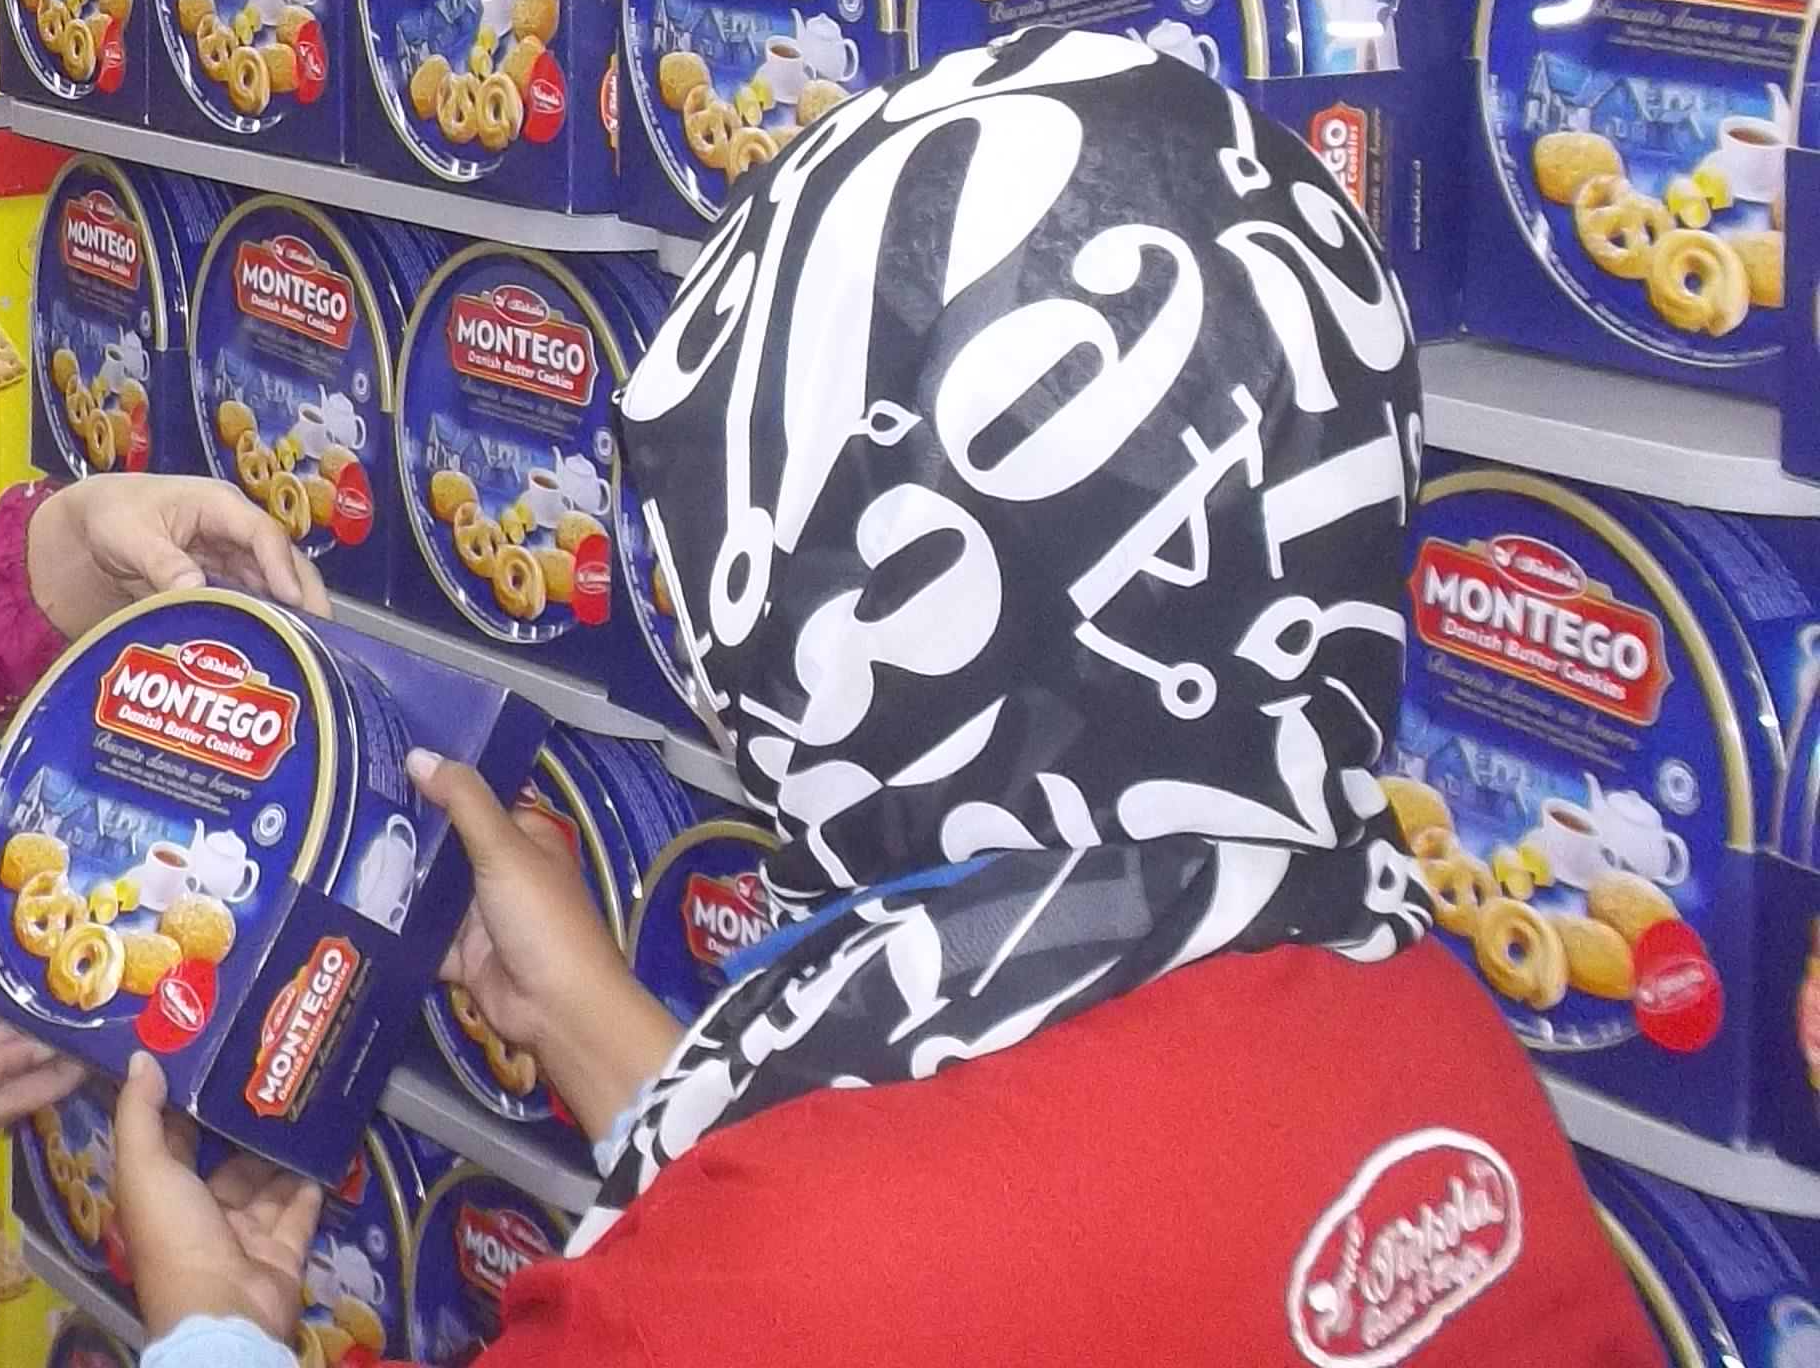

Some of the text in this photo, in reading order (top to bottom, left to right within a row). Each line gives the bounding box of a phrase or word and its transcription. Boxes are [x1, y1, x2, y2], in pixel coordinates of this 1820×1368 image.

[68, 221, 137, 265] MONTEGO
[242, 260, 347, 323] MONTEGO
[250, 293, 337, 336] Danish Butter Cookies
[456, 312, 586, 378] MONTEGO
[467, 350, 575, 392] Danish Butter Cookies
[1424, 565, 1650, 682] MONTEGO
[1442, 618, 1627, 701] Danish Butter Cookies
[112, 664, 282, 746] MONTEGO
[118, 705, 255, 762] Danish Butter Cookies
[257, 949, 343, 1104] MONTEGO
